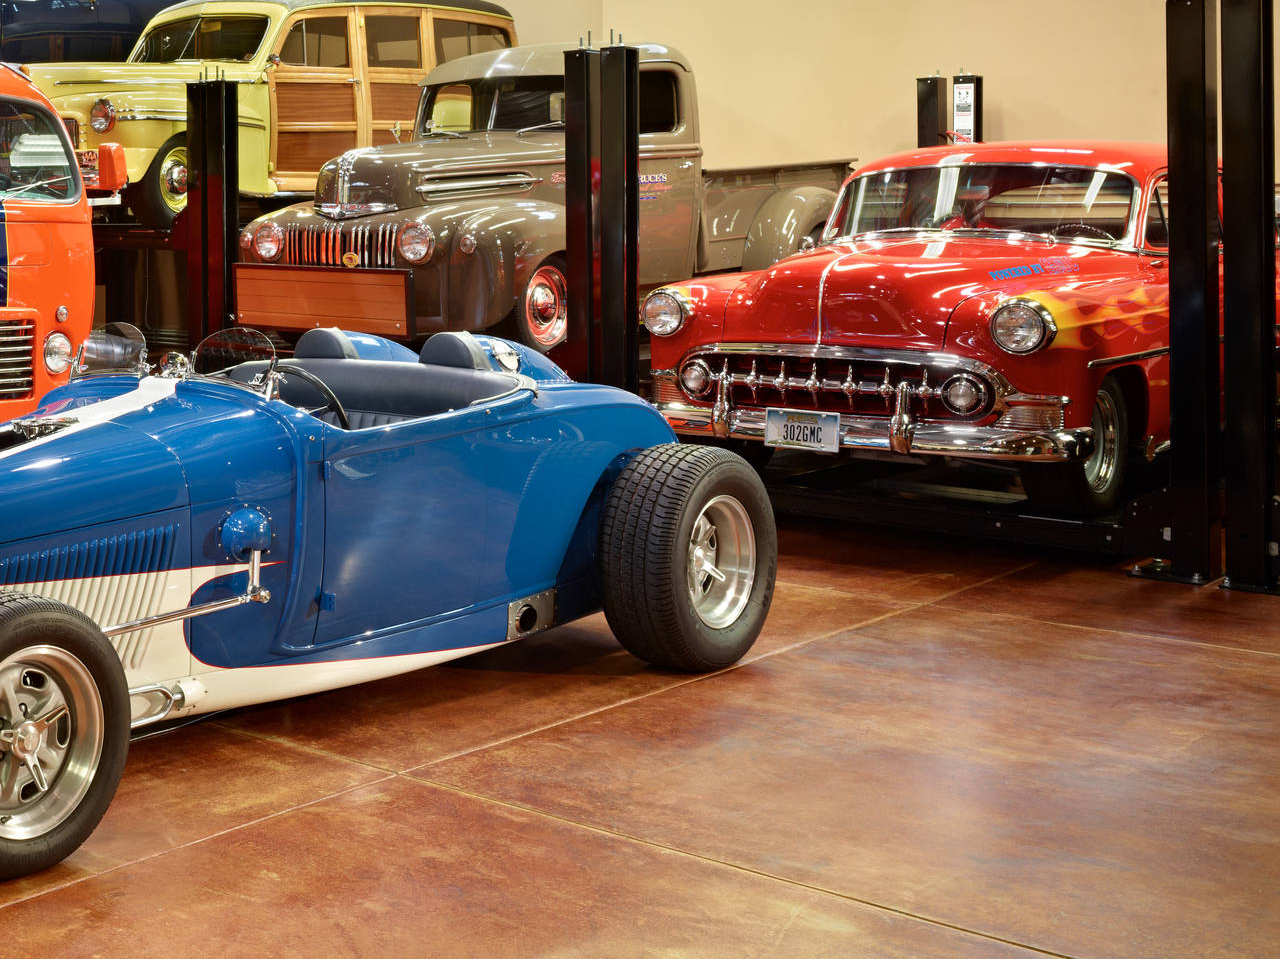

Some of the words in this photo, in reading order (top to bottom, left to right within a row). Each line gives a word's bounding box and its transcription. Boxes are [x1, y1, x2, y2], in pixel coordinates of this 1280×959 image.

[637, 173, 667, 184] RUCE'S
[987, 264, 1032, 282] POWERED
[1029, 263, 1046, 274] BY
[782, 423, 823, 443] 302GMC
